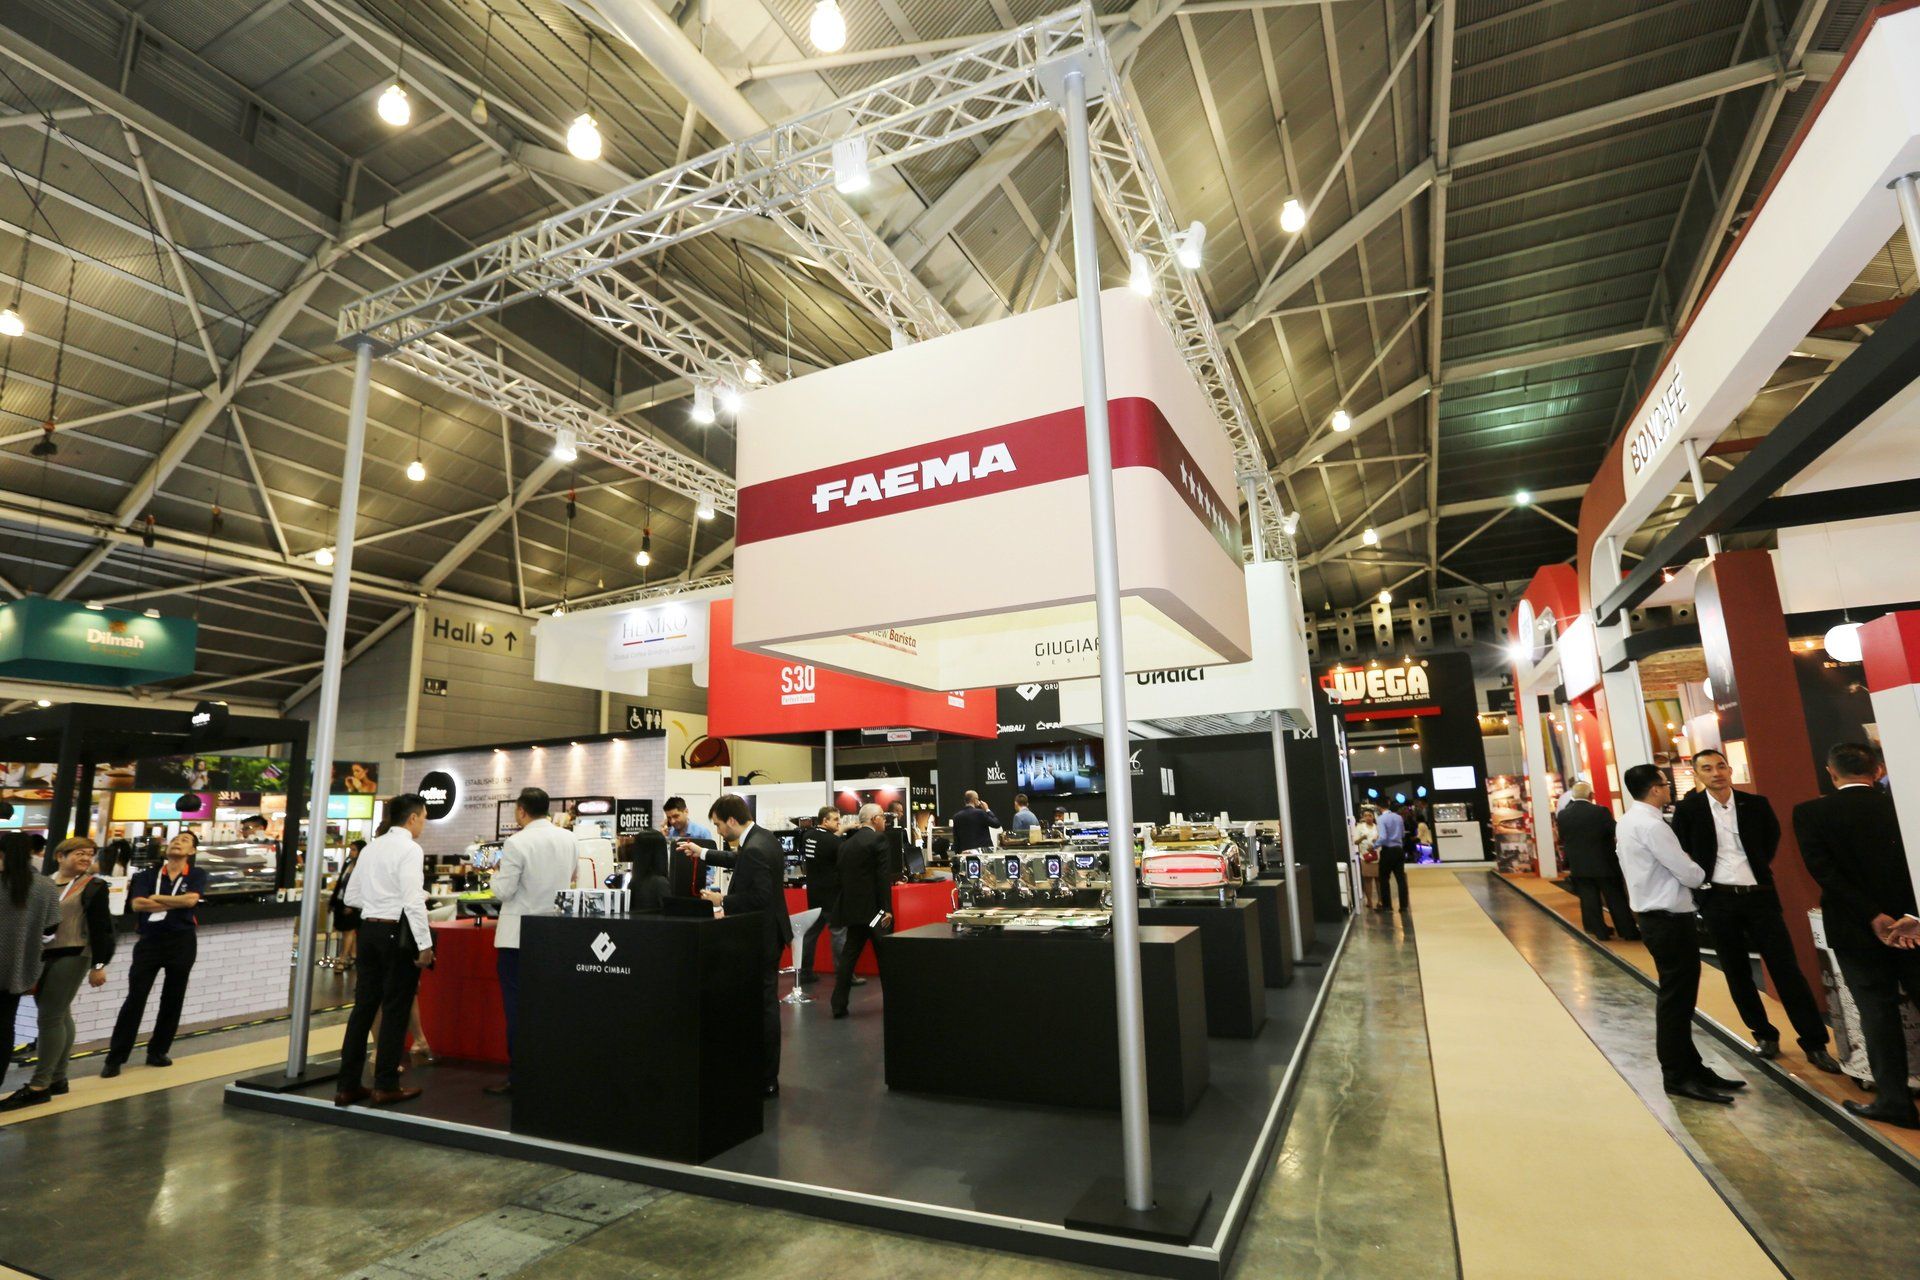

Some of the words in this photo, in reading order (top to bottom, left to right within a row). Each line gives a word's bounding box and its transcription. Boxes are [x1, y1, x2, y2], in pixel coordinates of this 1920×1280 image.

[1631, 363, 1688, 474] BONCAFÉ
[812, 442, 1017, 513] FAEMA
[86, 628, 145, 649] Dilmah
[433, 617, 475, 643] Hall
[481, 625, 494, 646] 5
[889, 629, 916, 648] Barista
[781, 665, 815, 693] S30
[1333, 666, 1430, 701] WEGA
[620, 814, 649, 828] COFFEE
[576, 964, 601, 973] GRUPPO
[604, 965, 631, 975] CIMBALI
